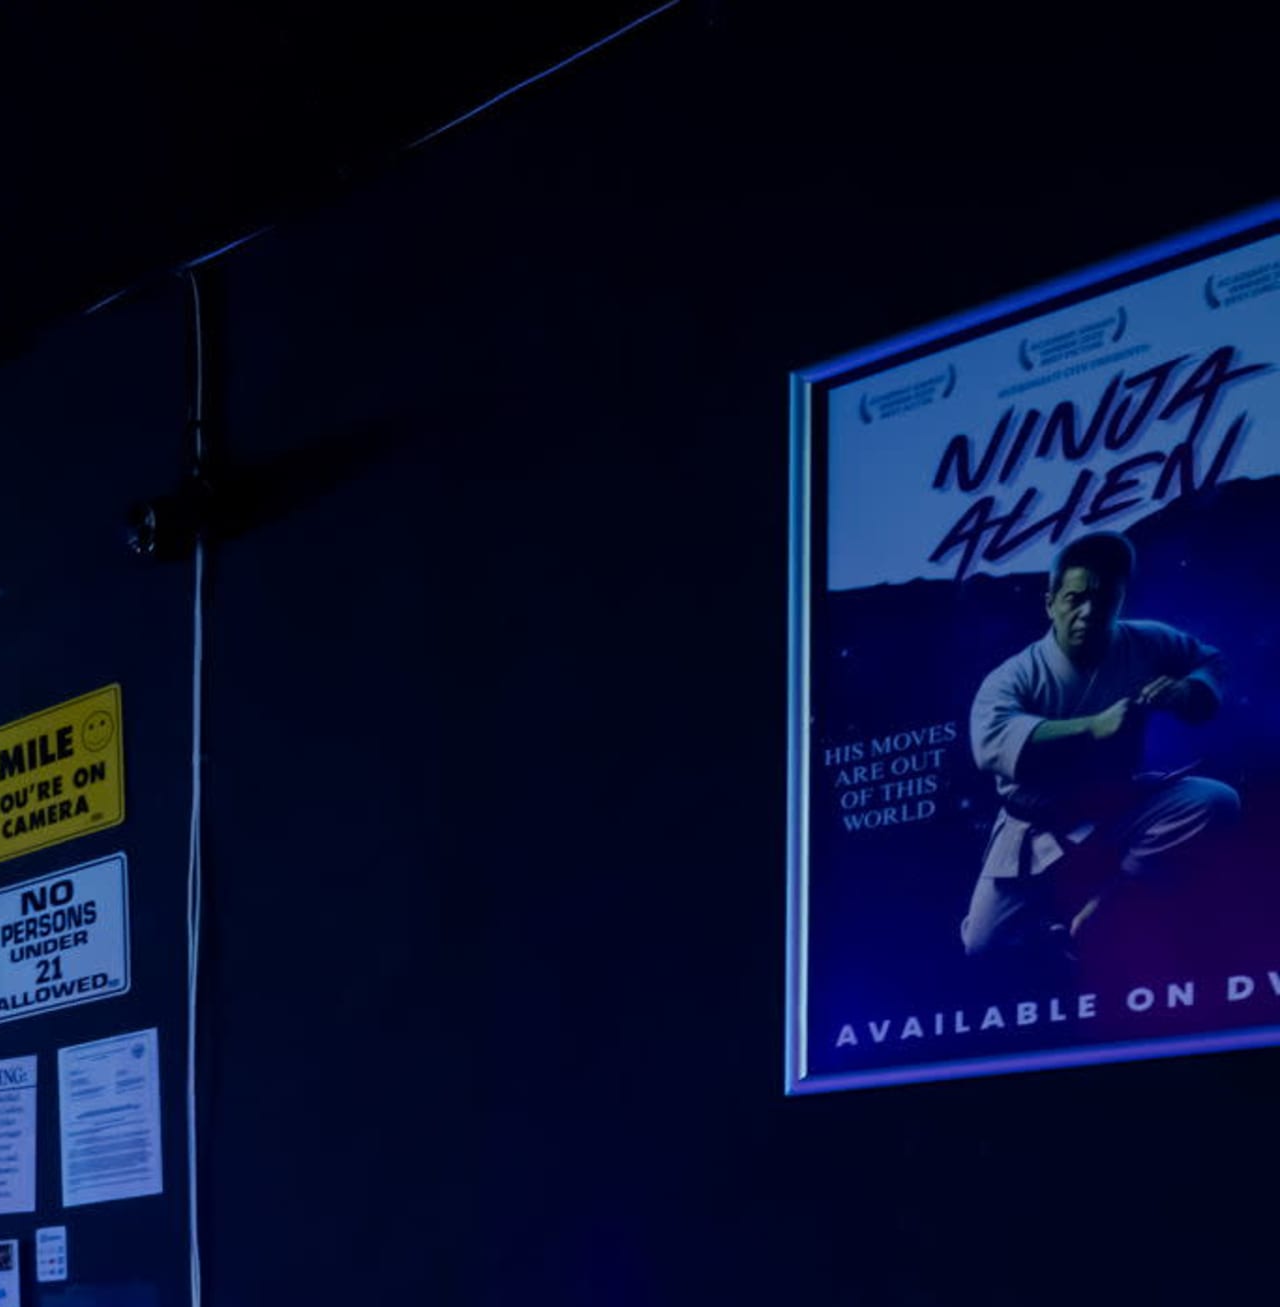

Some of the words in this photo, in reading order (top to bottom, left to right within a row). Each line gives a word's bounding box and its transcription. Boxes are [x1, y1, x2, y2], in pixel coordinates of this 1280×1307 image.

[931, 344, 1277, 494] NINJA
[928, 411, 1249, 582] ALIEN
[824, 741, 864, 767] HIS
[871, 721, 958, 755] MOVES
[73, 761, 107, 794] ON
[835, 762, 885, 788] ARE
[890, 748, 946, 777] OUT
[840, 785, 874, 811] OF
[880, 774, 938, 803] THIS
[1, 793, 90, 840] CAMERA
[842, 799, 936, 833] WORLD
[20, 879, 74, 916] NO
[1, 900, 98, 949] PERSONS
[9, 928, 89, 964] UNDER
[35, 956, 63, 985] 21
[835, 993, 1098, 1048] AVAILABLE
[1126, 981, 1195, 1012] ON
